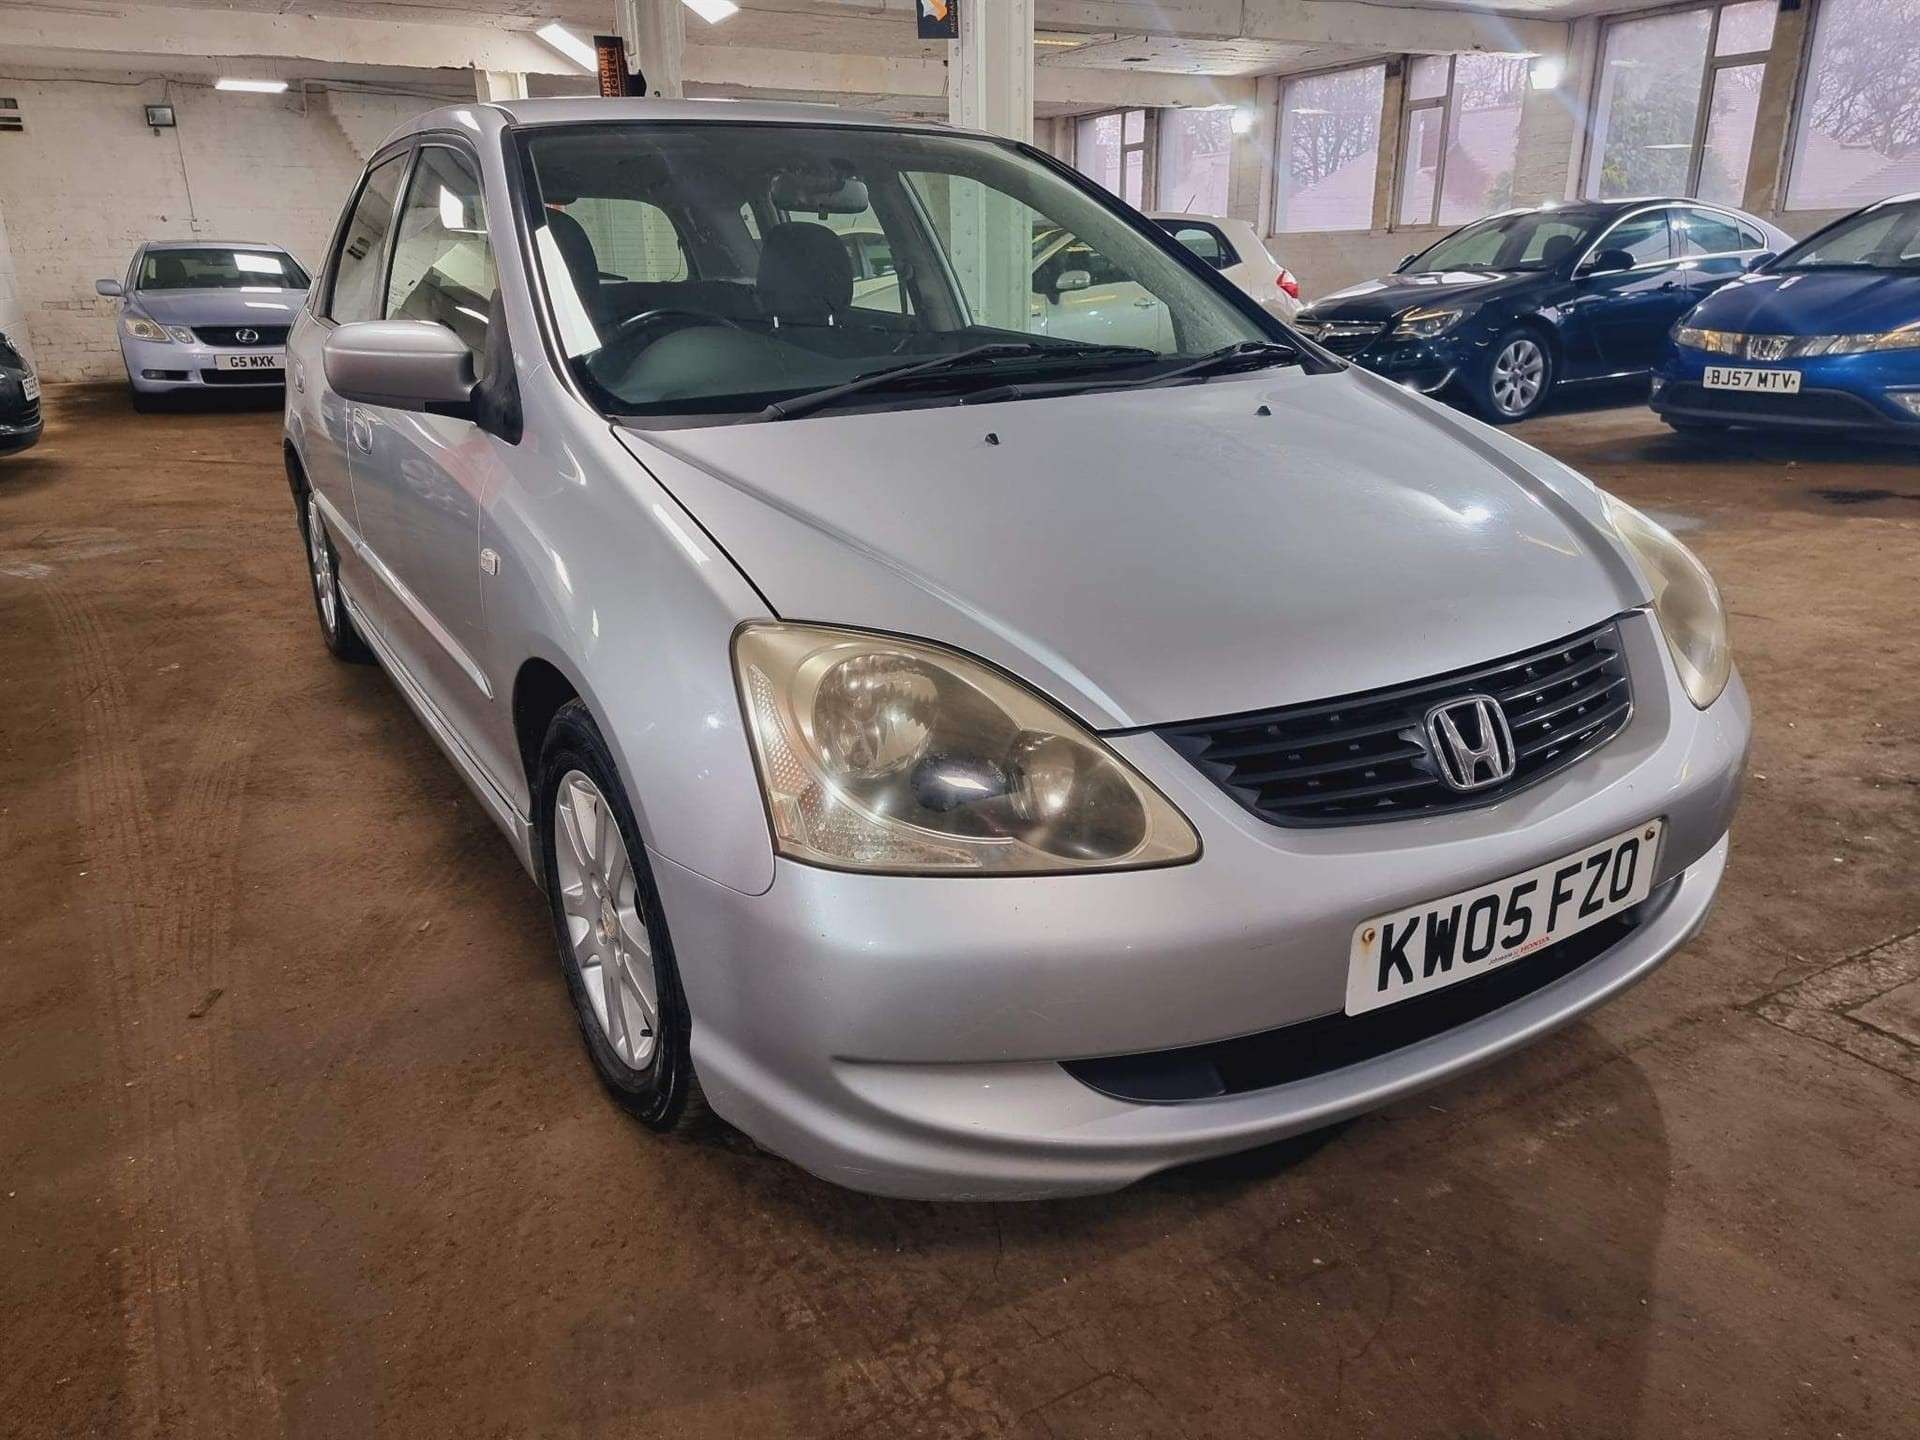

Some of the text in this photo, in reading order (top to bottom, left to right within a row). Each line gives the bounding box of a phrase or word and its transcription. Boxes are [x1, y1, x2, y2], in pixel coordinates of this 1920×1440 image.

[608, 47, 619, 97] ROTECT
[230, 355, 276, 368] G5 MXK
[1710, 369, 1793, 389] BJ57 MTV
[1377, 837, 1640, 992] KW05 FZO
